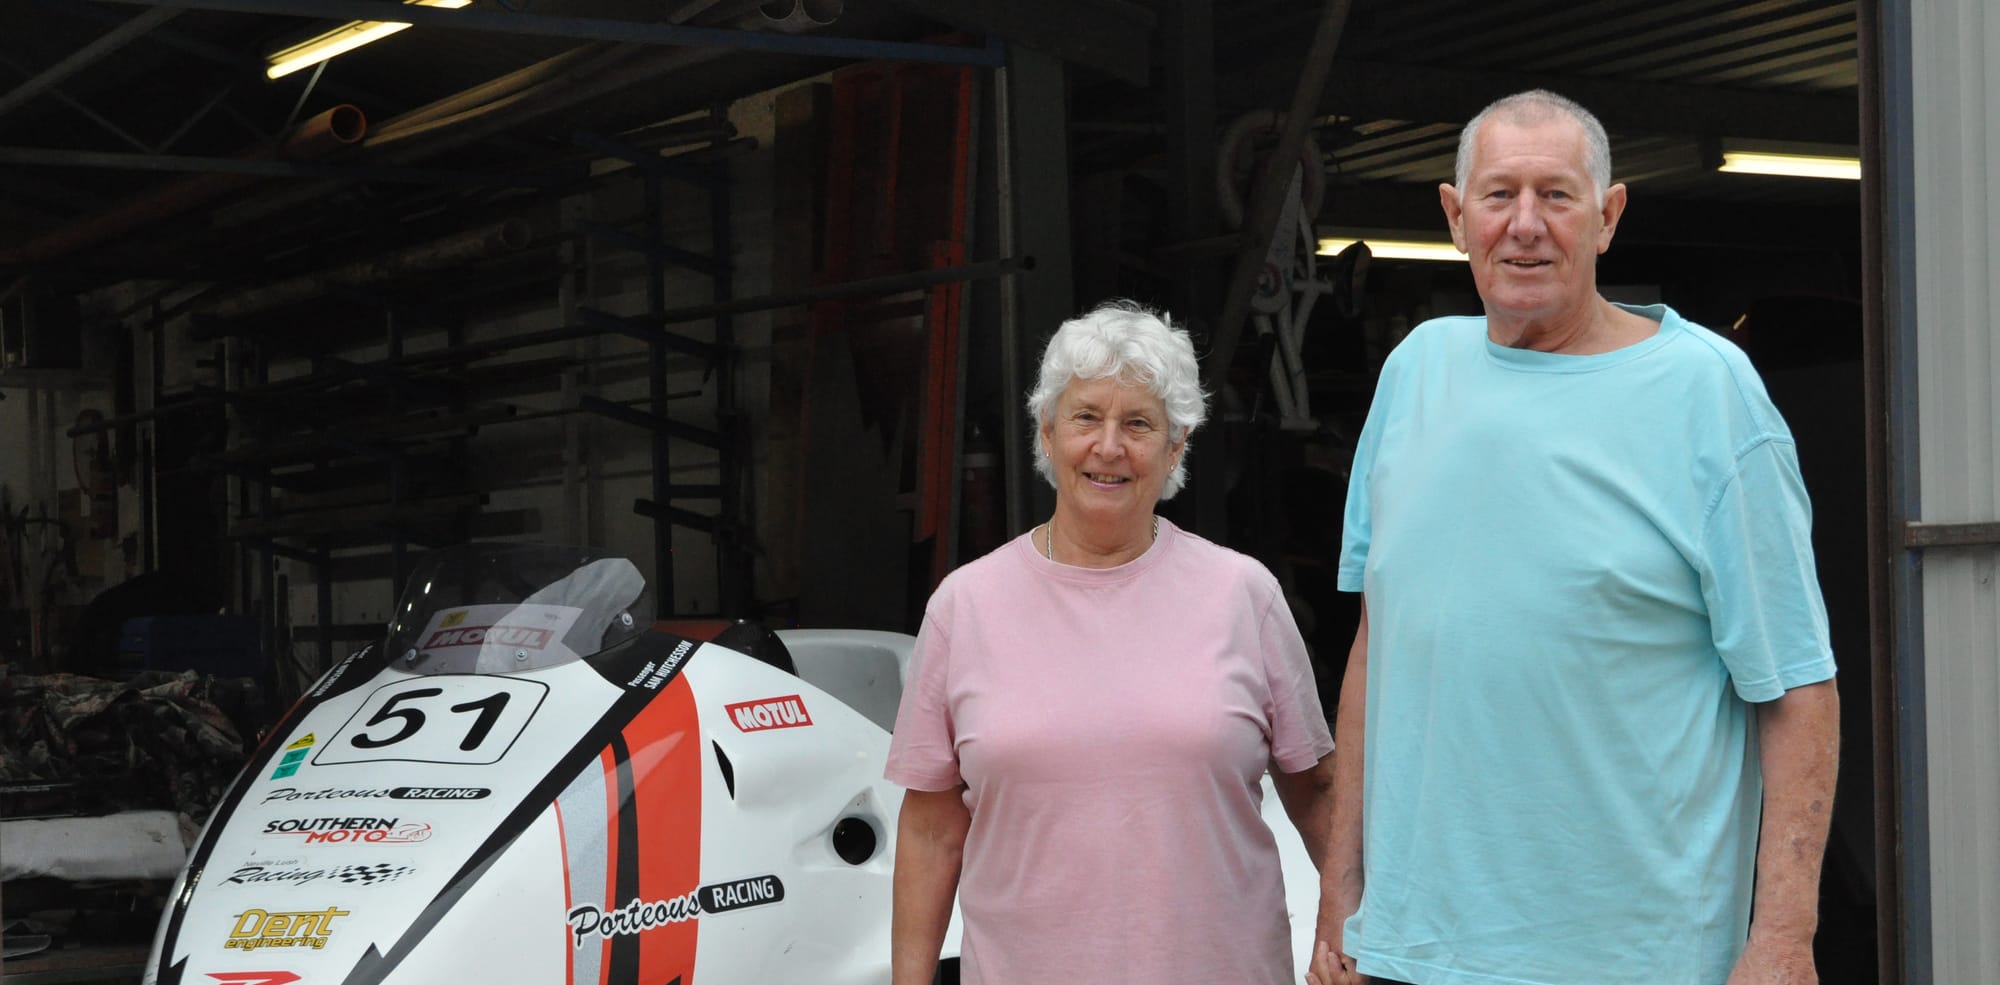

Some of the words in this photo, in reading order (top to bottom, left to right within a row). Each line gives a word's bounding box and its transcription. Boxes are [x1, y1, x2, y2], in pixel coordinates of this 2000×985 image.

[628, 661, 655, 687] Passenger
[644, 671, 664, 690] SAM
[656, 640, 694, 678] HUTCHESSON
[351, 688, 511, 752] 51
[734, 700, 807, 730] MOTUL
[260, 787, 391, 805] Porteous
[402, 788, 481, 799] RACING
[263, 817, 399, 833] SOUTHERN
[305, 829, 388, 844] MOTO
[218, 866, 325, 887] Racing
[230, 906, 350, 938] Dent
[569, 892, 700, 947] Porteous
[712, 878, 775, 909] RACING
[224, 936, 328, 951] engineering
